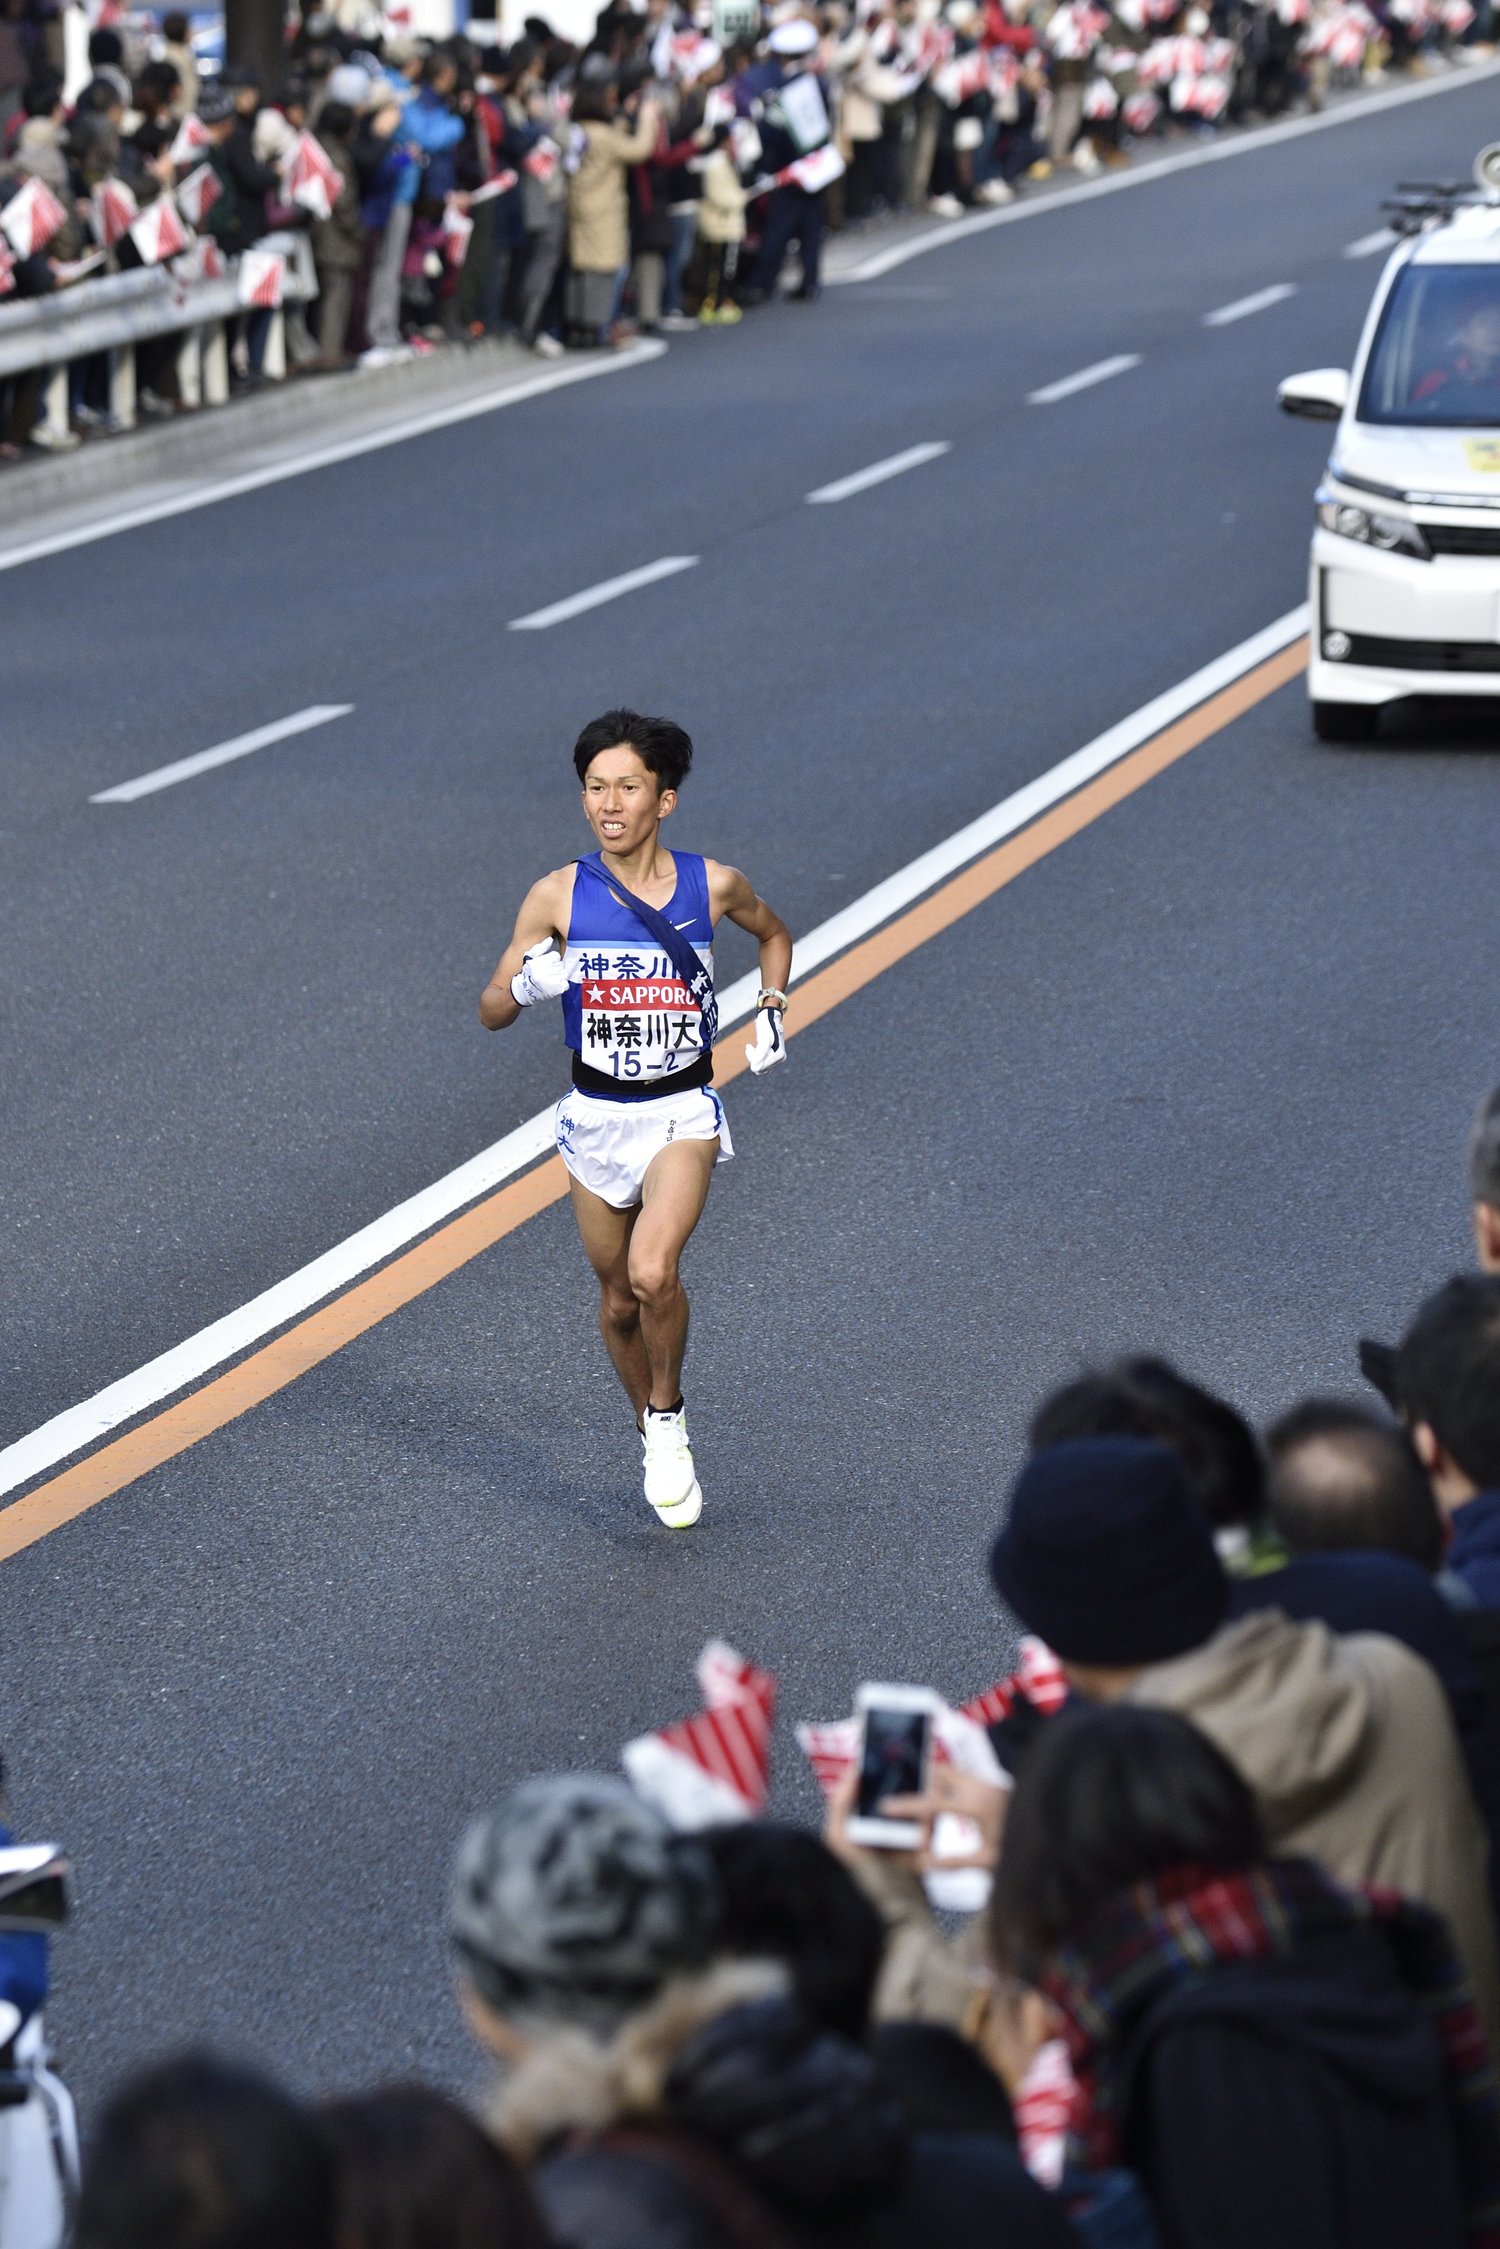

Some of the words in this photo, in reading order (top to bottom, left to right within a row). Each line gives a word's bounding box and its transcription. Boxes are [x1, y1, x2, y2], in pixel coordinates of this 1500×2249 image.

[586, 1012, 698, 1050] 神奈川大
[608, 1050, 680, 1077] 15-2
